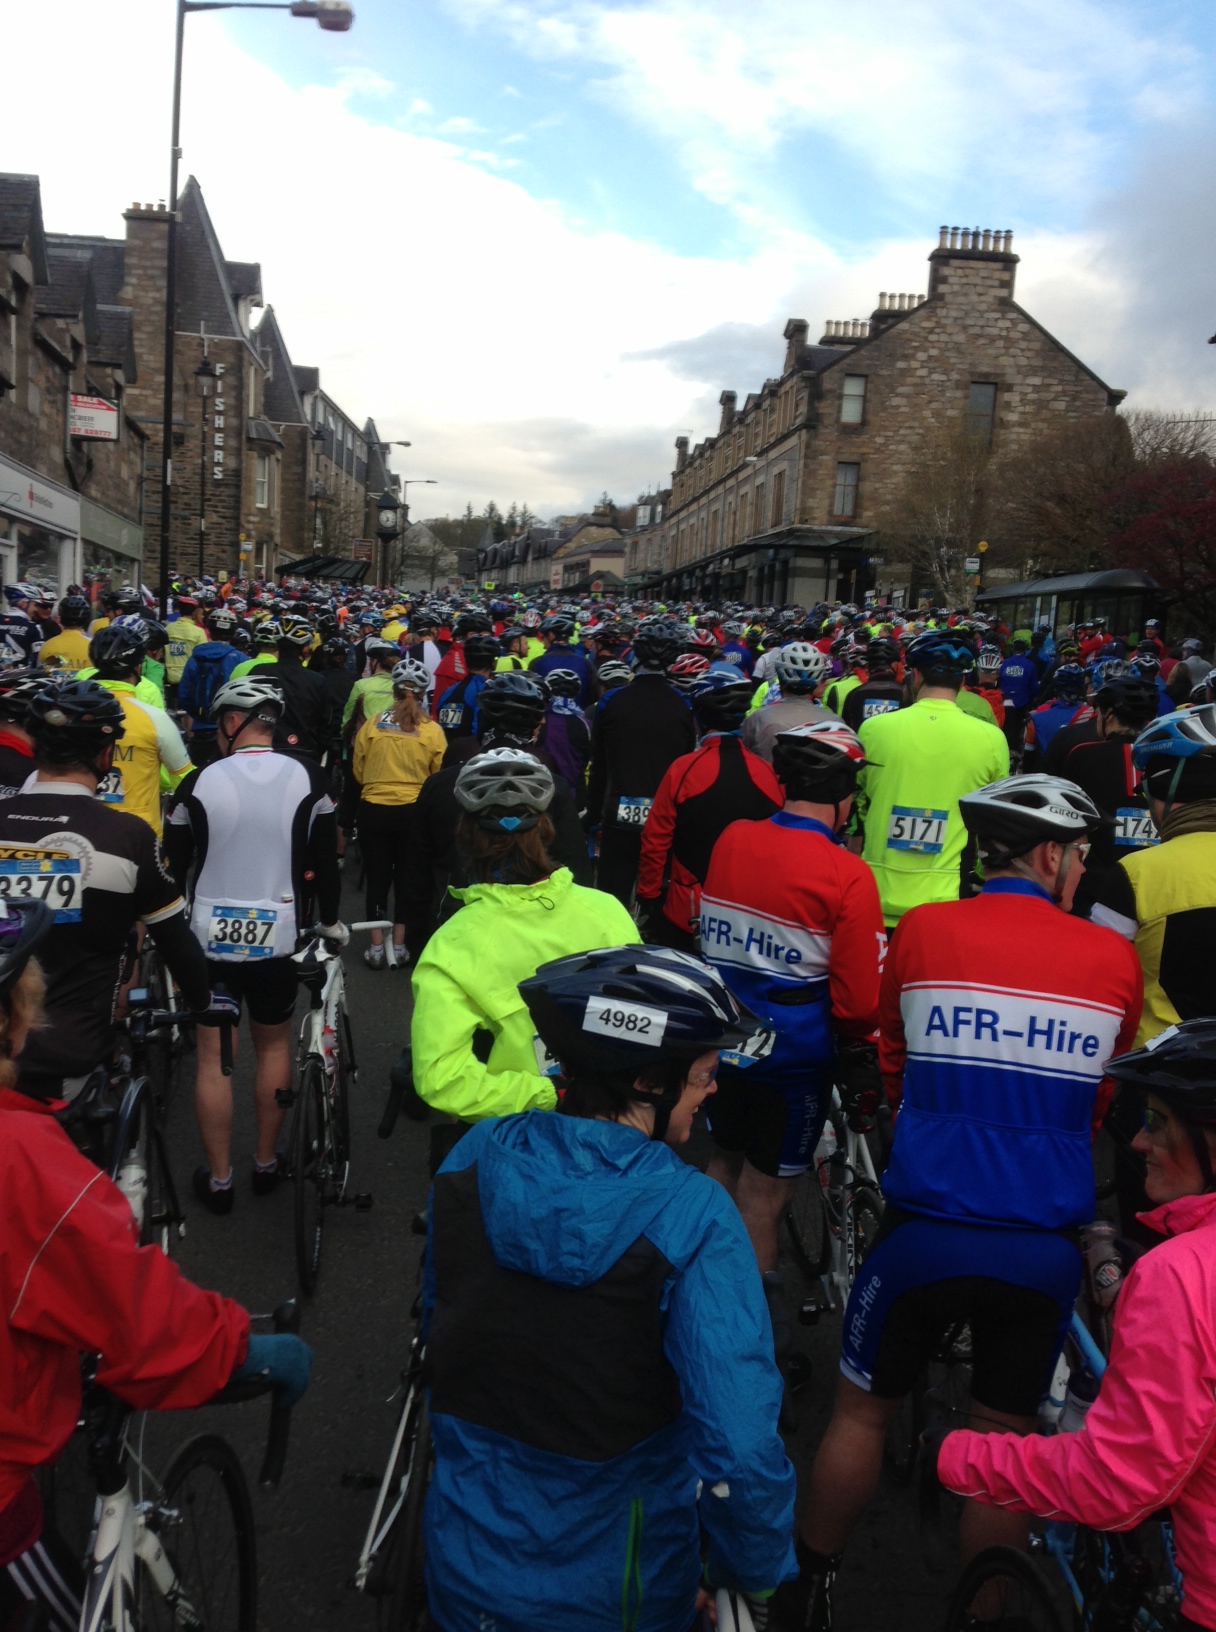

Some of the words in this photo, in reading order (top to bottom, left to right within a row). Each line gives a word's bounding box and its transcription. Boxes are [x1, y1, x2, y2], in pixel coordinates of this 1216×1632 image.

[213, 363, 225, 479] FISHERS
[7, 814, 63, 823] ENDURA
[892, 817, 943, 843] 5171
[1049, 806, 1079, 820] GIRO
[213, 918, 274, 945] 3887
[701, 914, 803, 965] AFR-Hire
[599, 1008, 652, 1034] 4982
[925, 1005, 1100, 1058] AFR-Hire
[799, 1094, 818, 1154] AFR-Hire
[850, 1274, 882, 1352] AFR-Hire
